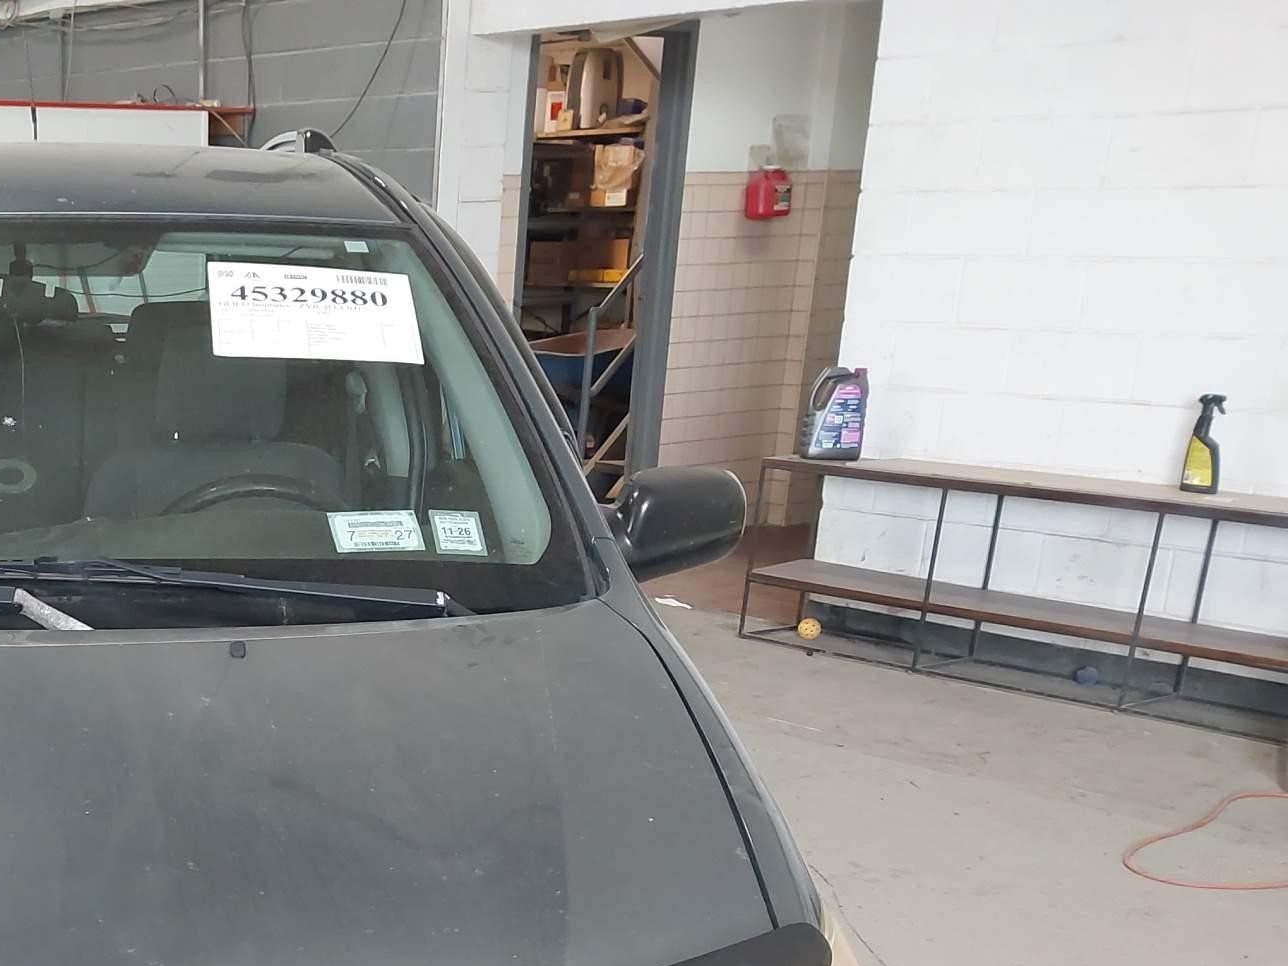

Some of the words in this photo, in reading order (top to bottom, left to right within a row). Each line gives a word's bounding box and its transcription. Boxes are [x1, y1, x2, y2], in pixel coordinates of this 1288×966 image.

[230, 285, 388, 307] 45329880
[346, 530, 356, 542] 7
[394, 529, 413, 541] 27
[440, 527, 472, 536] 11-26
